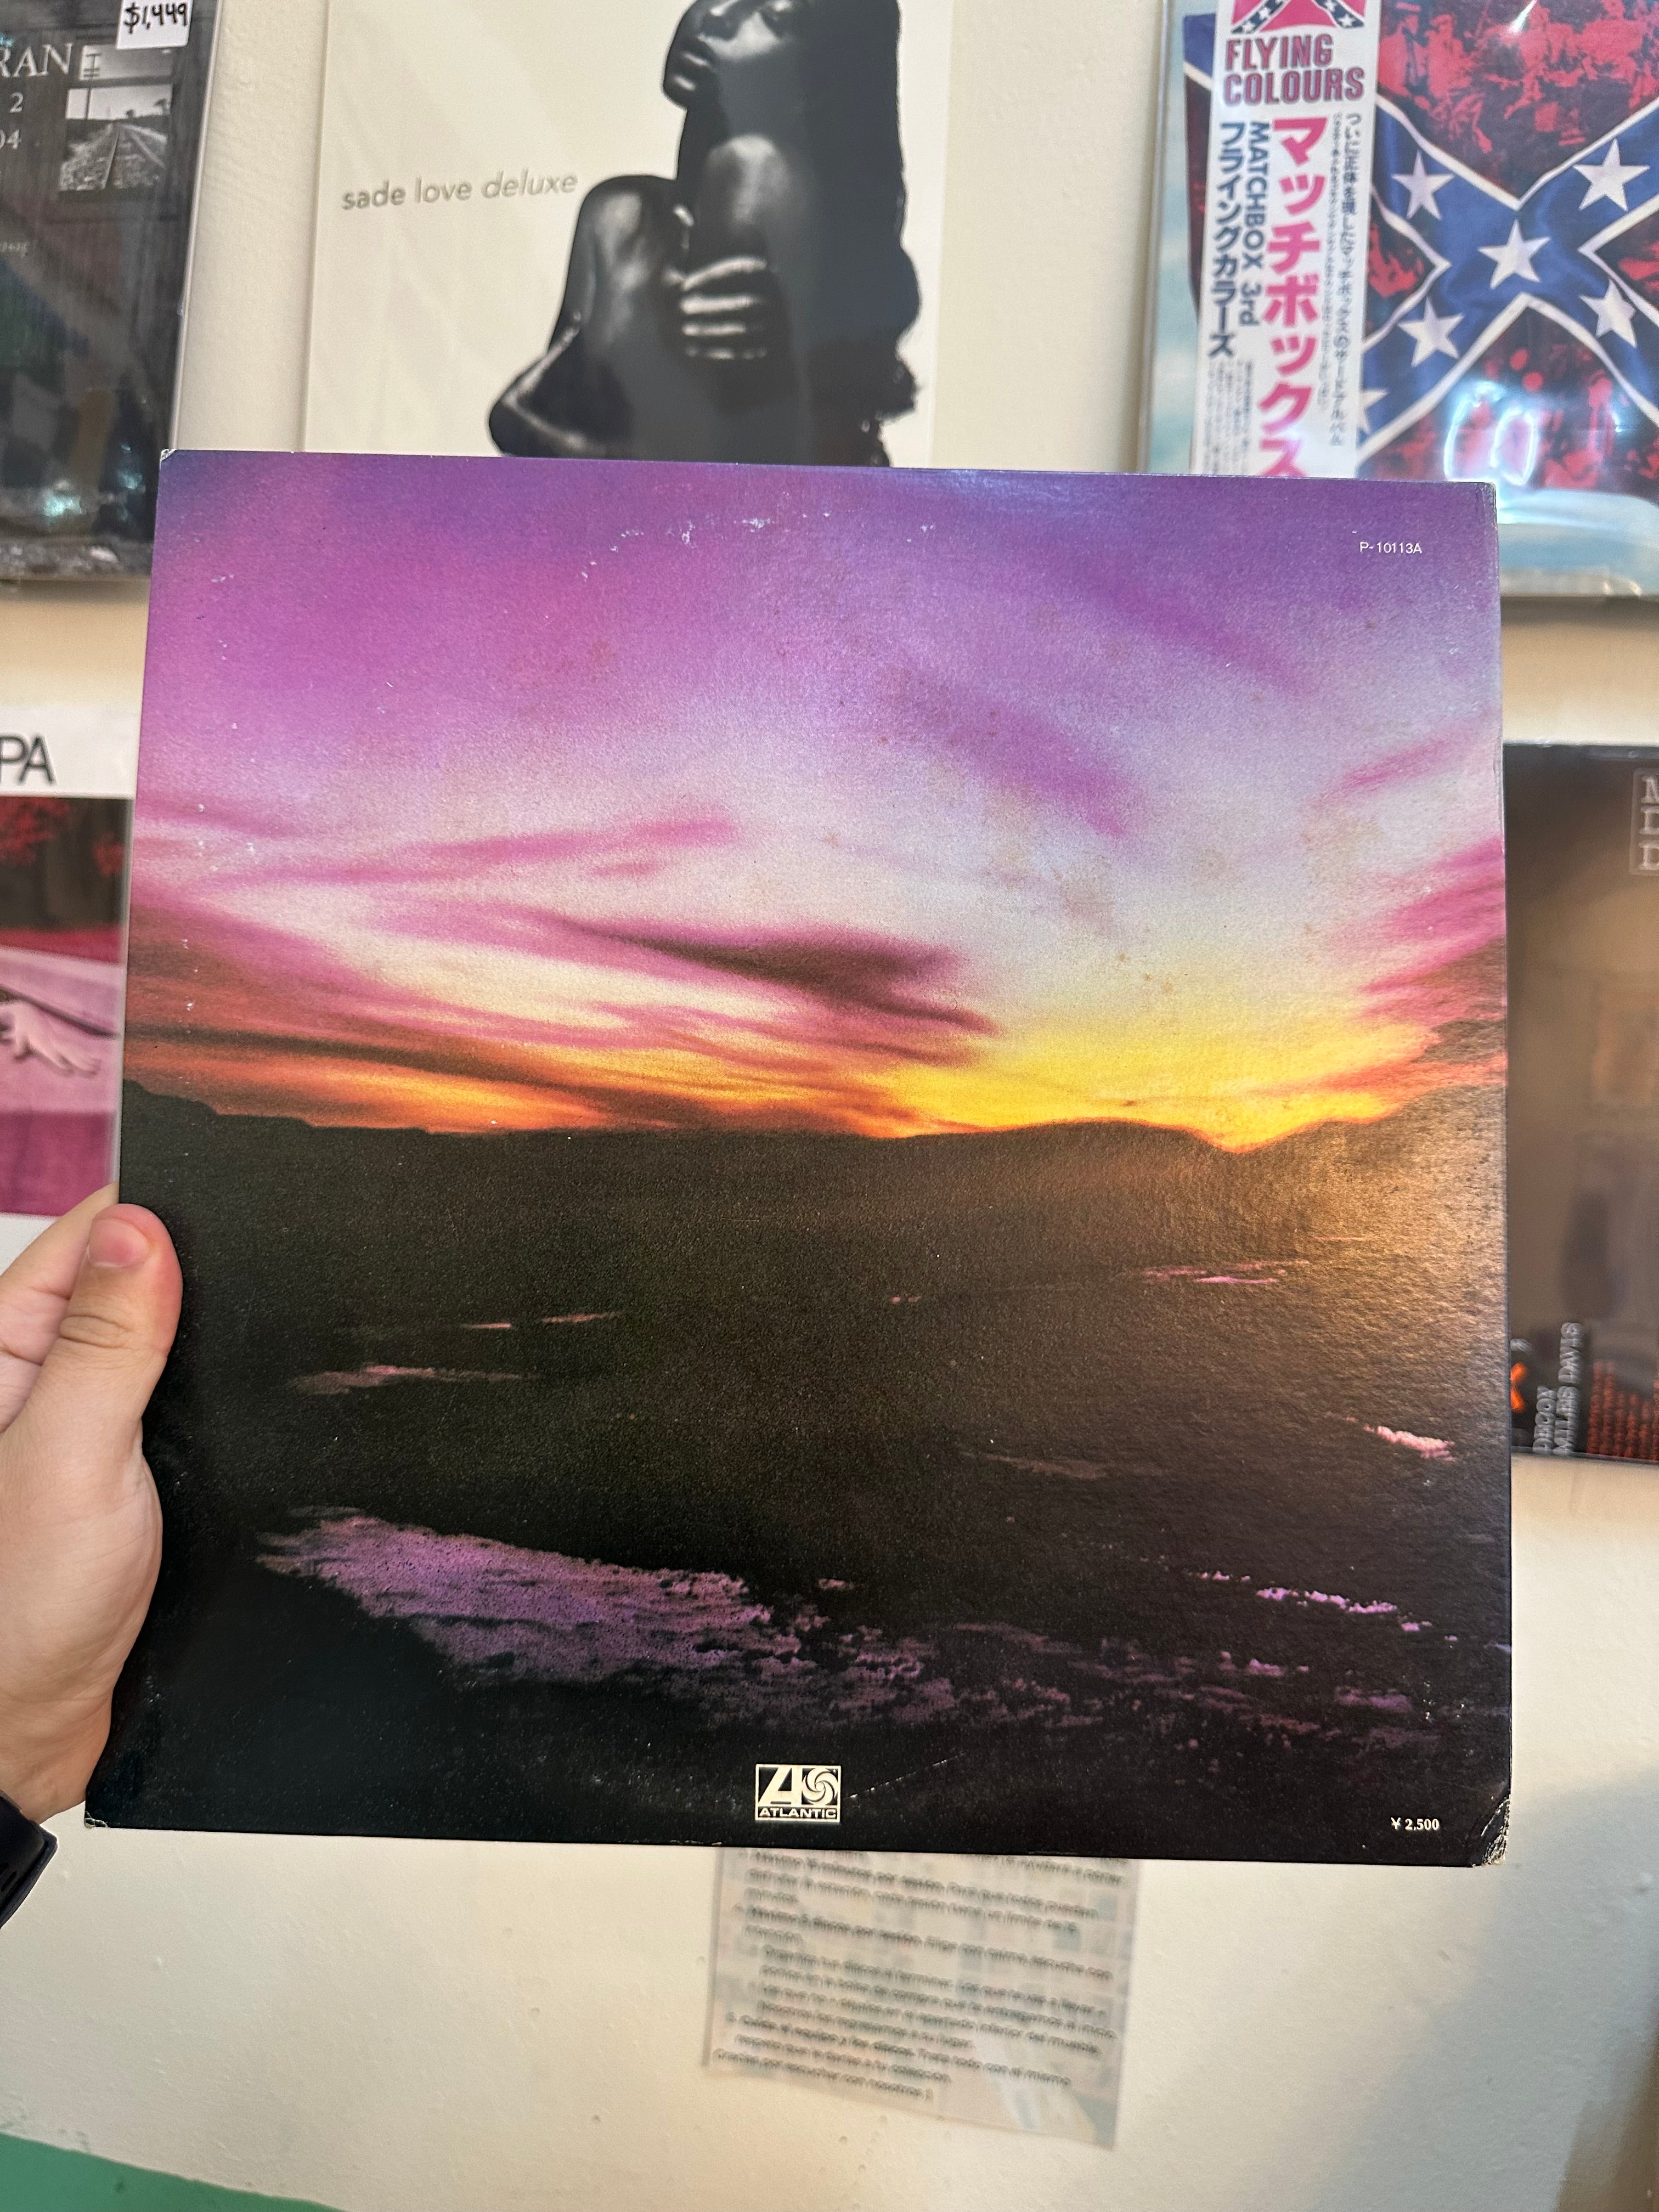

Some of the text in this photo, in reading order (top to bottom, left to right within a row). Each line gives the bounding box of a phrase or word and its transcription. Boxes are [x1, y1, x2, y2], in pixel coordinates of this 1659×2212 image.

[124, 2, 188, 34] $1,449
[1224, 33, 1334, 72] FLYING
[9, 92, 24, 113] 2
[1223, 67, 1365, 106] COLOURS
[342, 166, 578, 210] sade love deluxe
[1238, 121, 1271, 326] MATCHBOX 3rd
[1359, 541, 1423, 554] P-10113A
[1558, 1322, 1582, 1384] DAVIS
[759, 1807, 837, 1819] ATLANTIC
